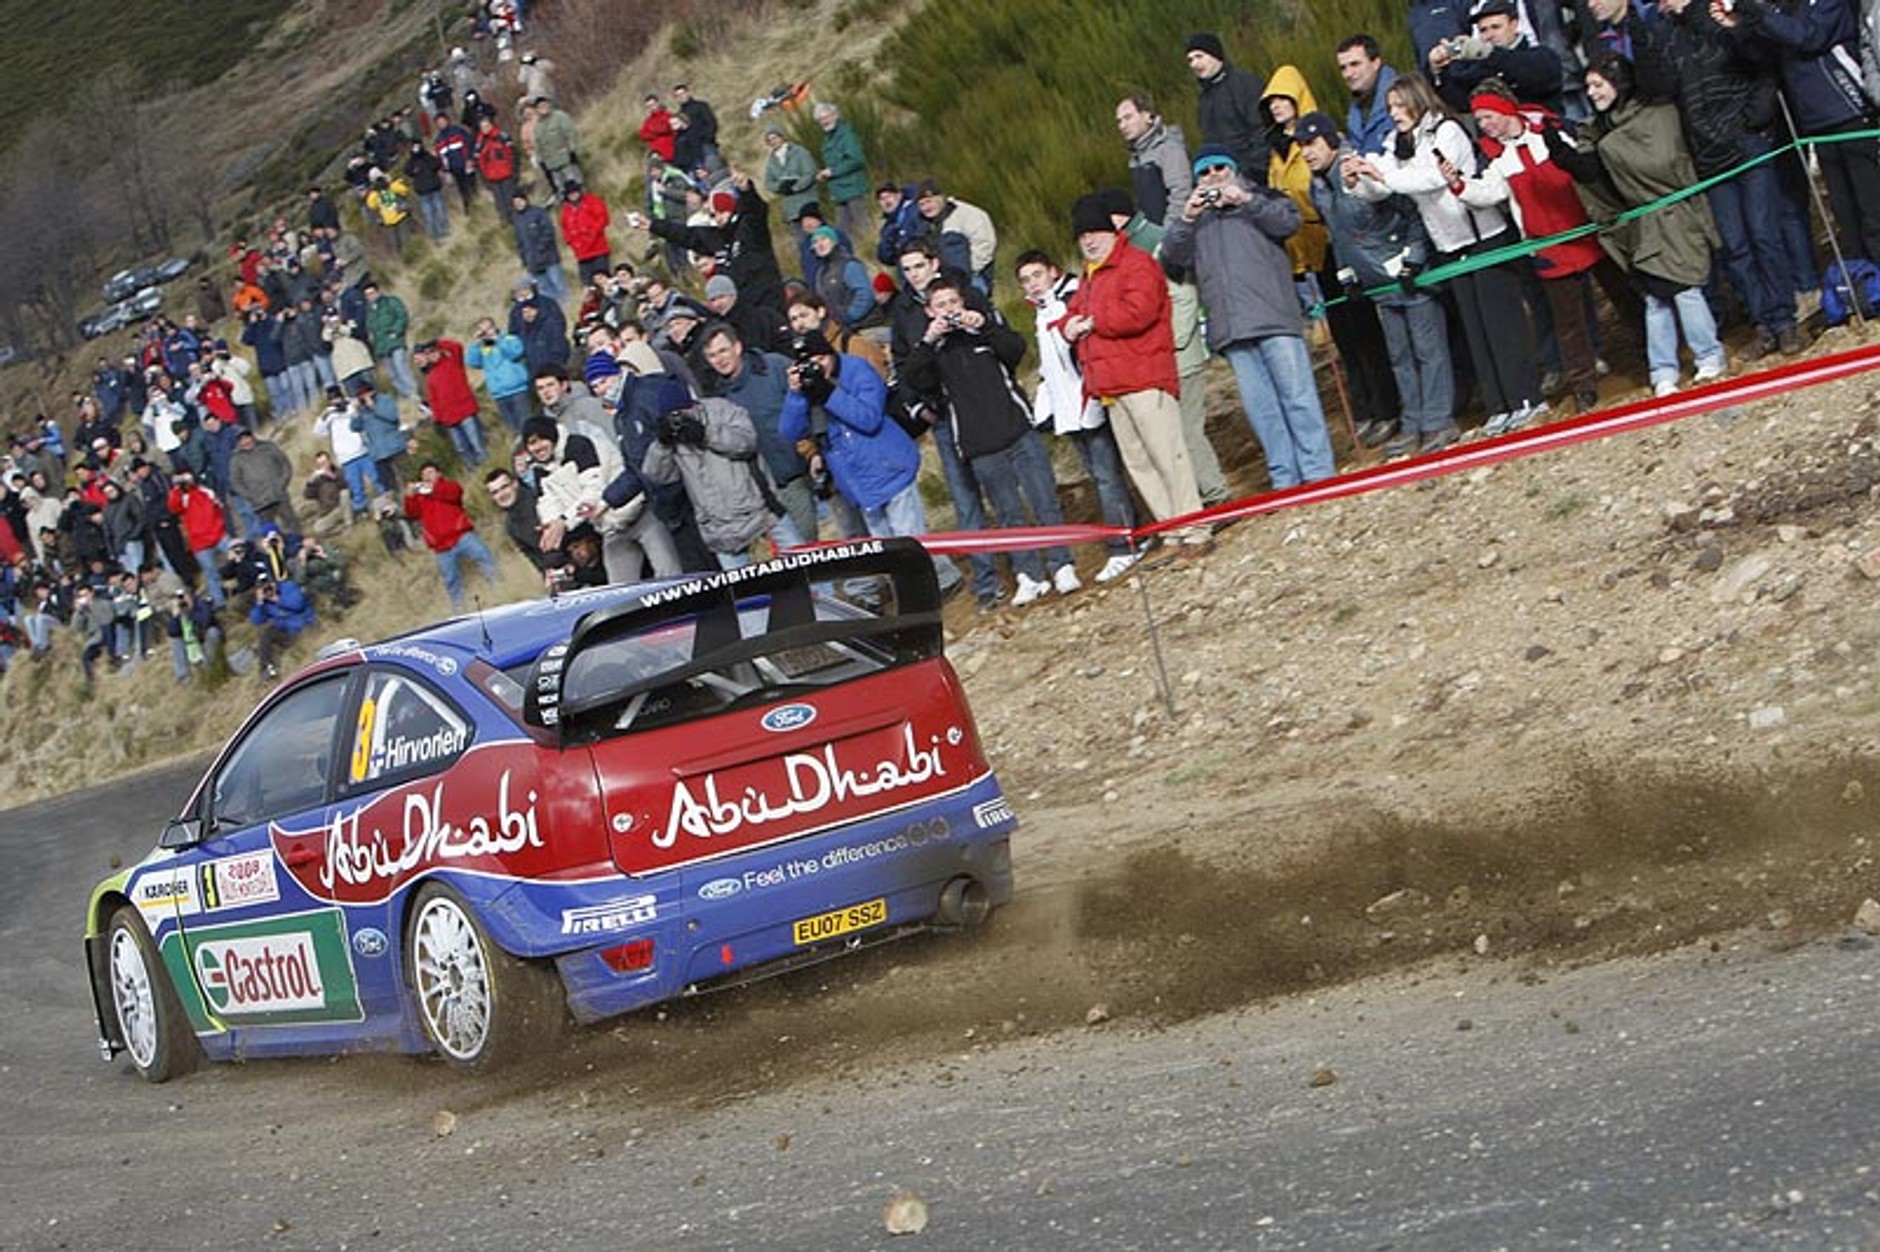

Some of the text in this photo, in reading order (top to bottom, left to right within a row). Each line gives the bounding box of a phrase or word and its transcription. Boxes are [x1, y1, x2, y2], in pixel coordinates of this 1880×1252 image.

[639, 540, 885, 608] WWW.VISITABUDHABI.AE
[351, 698, 375, 782] 3
[385, 730, 466, 770] Hirvonen
[743, 865, 786, 891] Feel
[786, 859, 819, 879] the
[822, 835, 908, 870] difference
[561, 895, 657, 934] PIRELLI
[798, 904, 884, 941] EU07 SSZ
[225, 943, 321, 1004] Castrol
